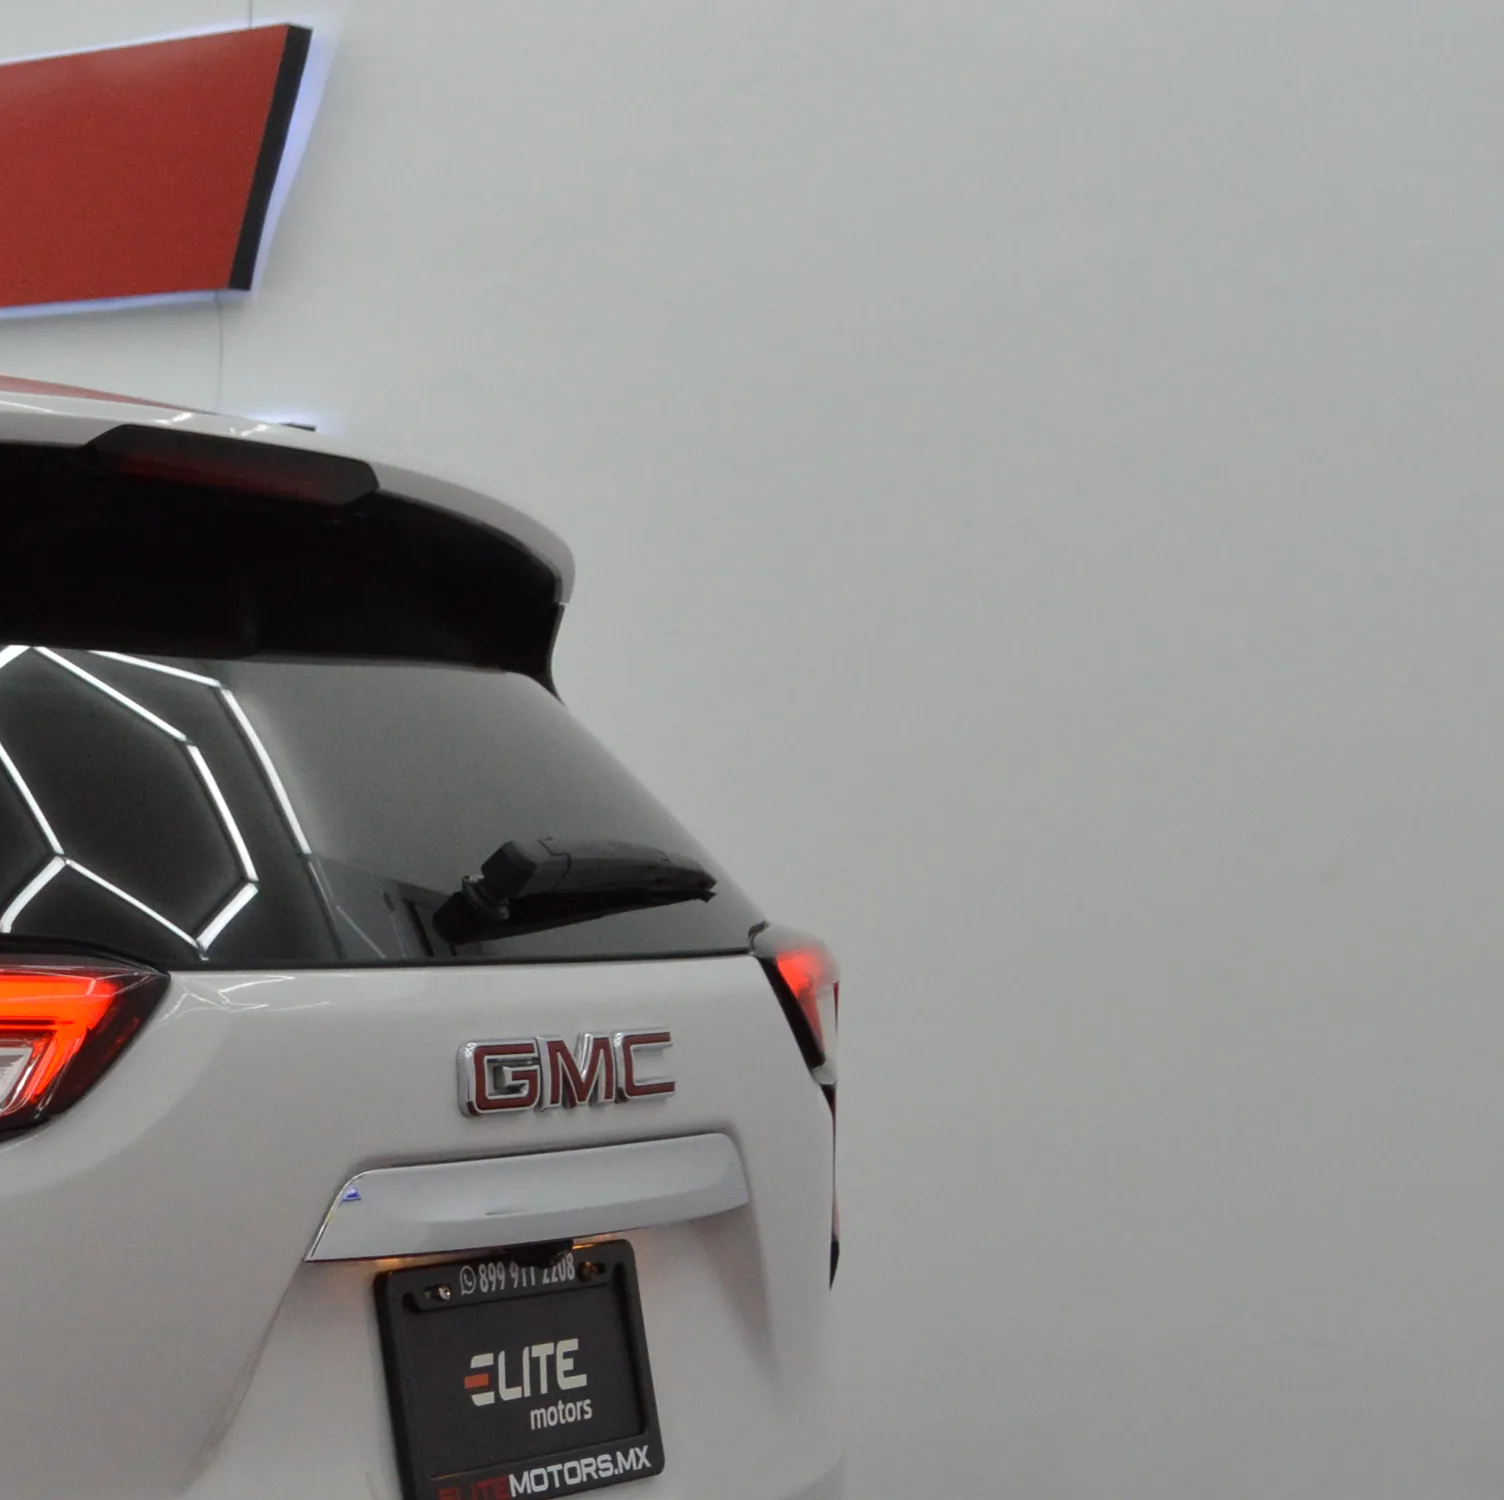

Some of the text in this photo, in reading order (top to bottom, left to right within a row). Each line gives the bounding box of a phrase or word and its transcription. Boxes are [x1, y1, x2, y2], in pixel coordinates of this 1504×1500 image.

[456, 1026, 676, 1117] GMC
[478, 1262, 506, 1293] 899
[509, 1261, 536, 1288] 911
[463, 1338, 588, 1407] ELITE
[530, 1398, 593, 1430] motors
